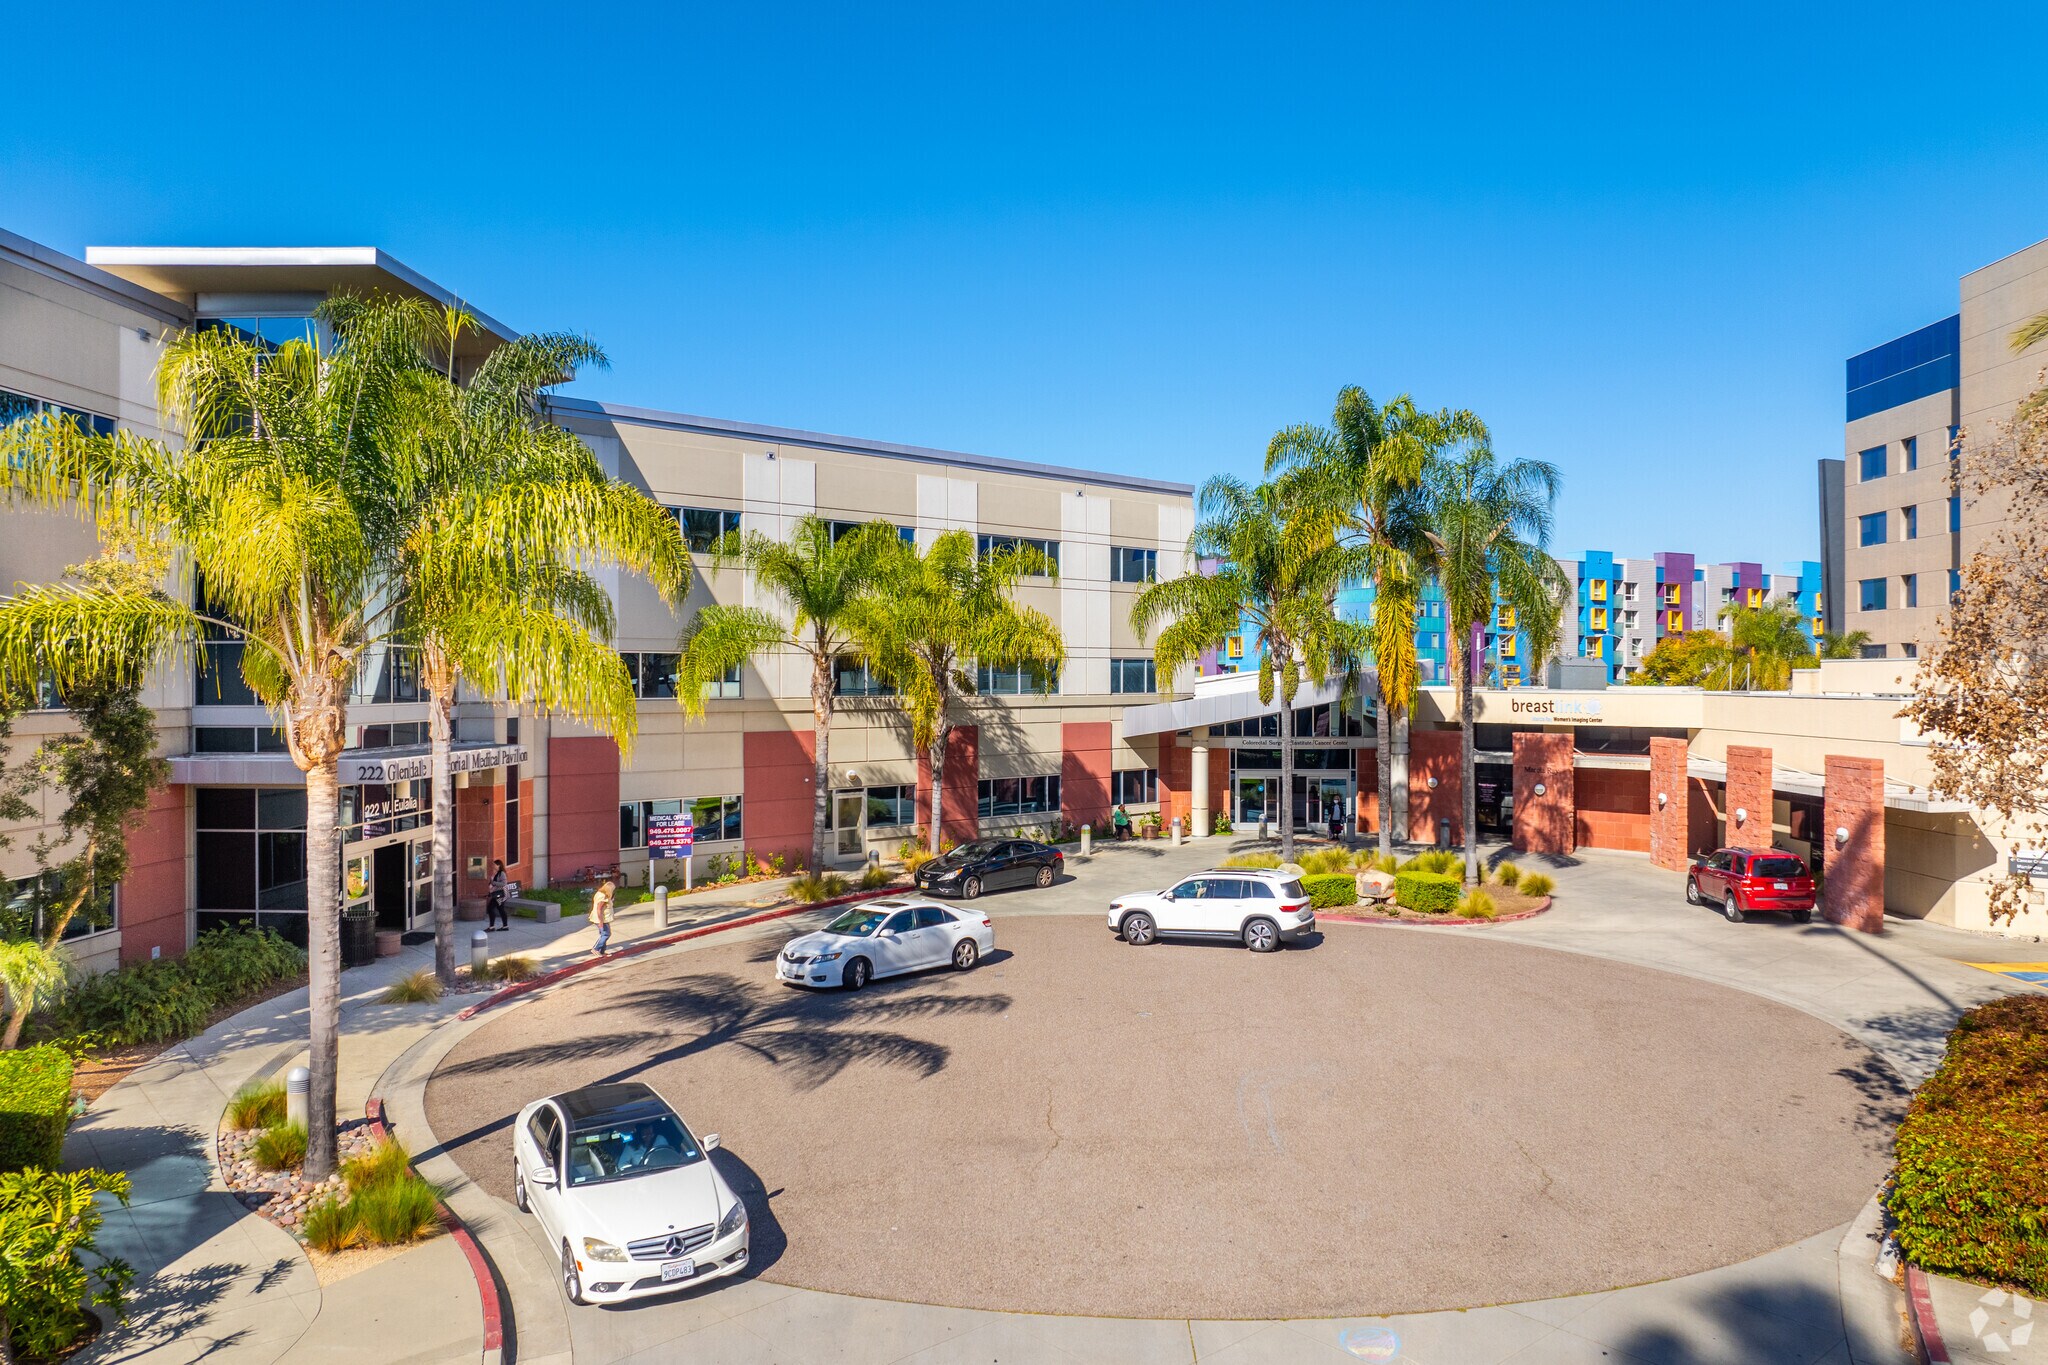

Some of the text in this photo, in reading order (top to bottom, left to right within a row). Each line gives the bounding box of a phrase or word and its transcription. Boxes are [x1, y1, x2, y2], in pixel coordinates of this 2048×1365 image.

[358, 766, 384, 780] 222
[387, 760, 427, 781] Glendale
[472, 751, 499, 769] Medical
[501, 748, 528, 764] Pavilion
[365, 797, 417, 818] 222 W. Eulalia
